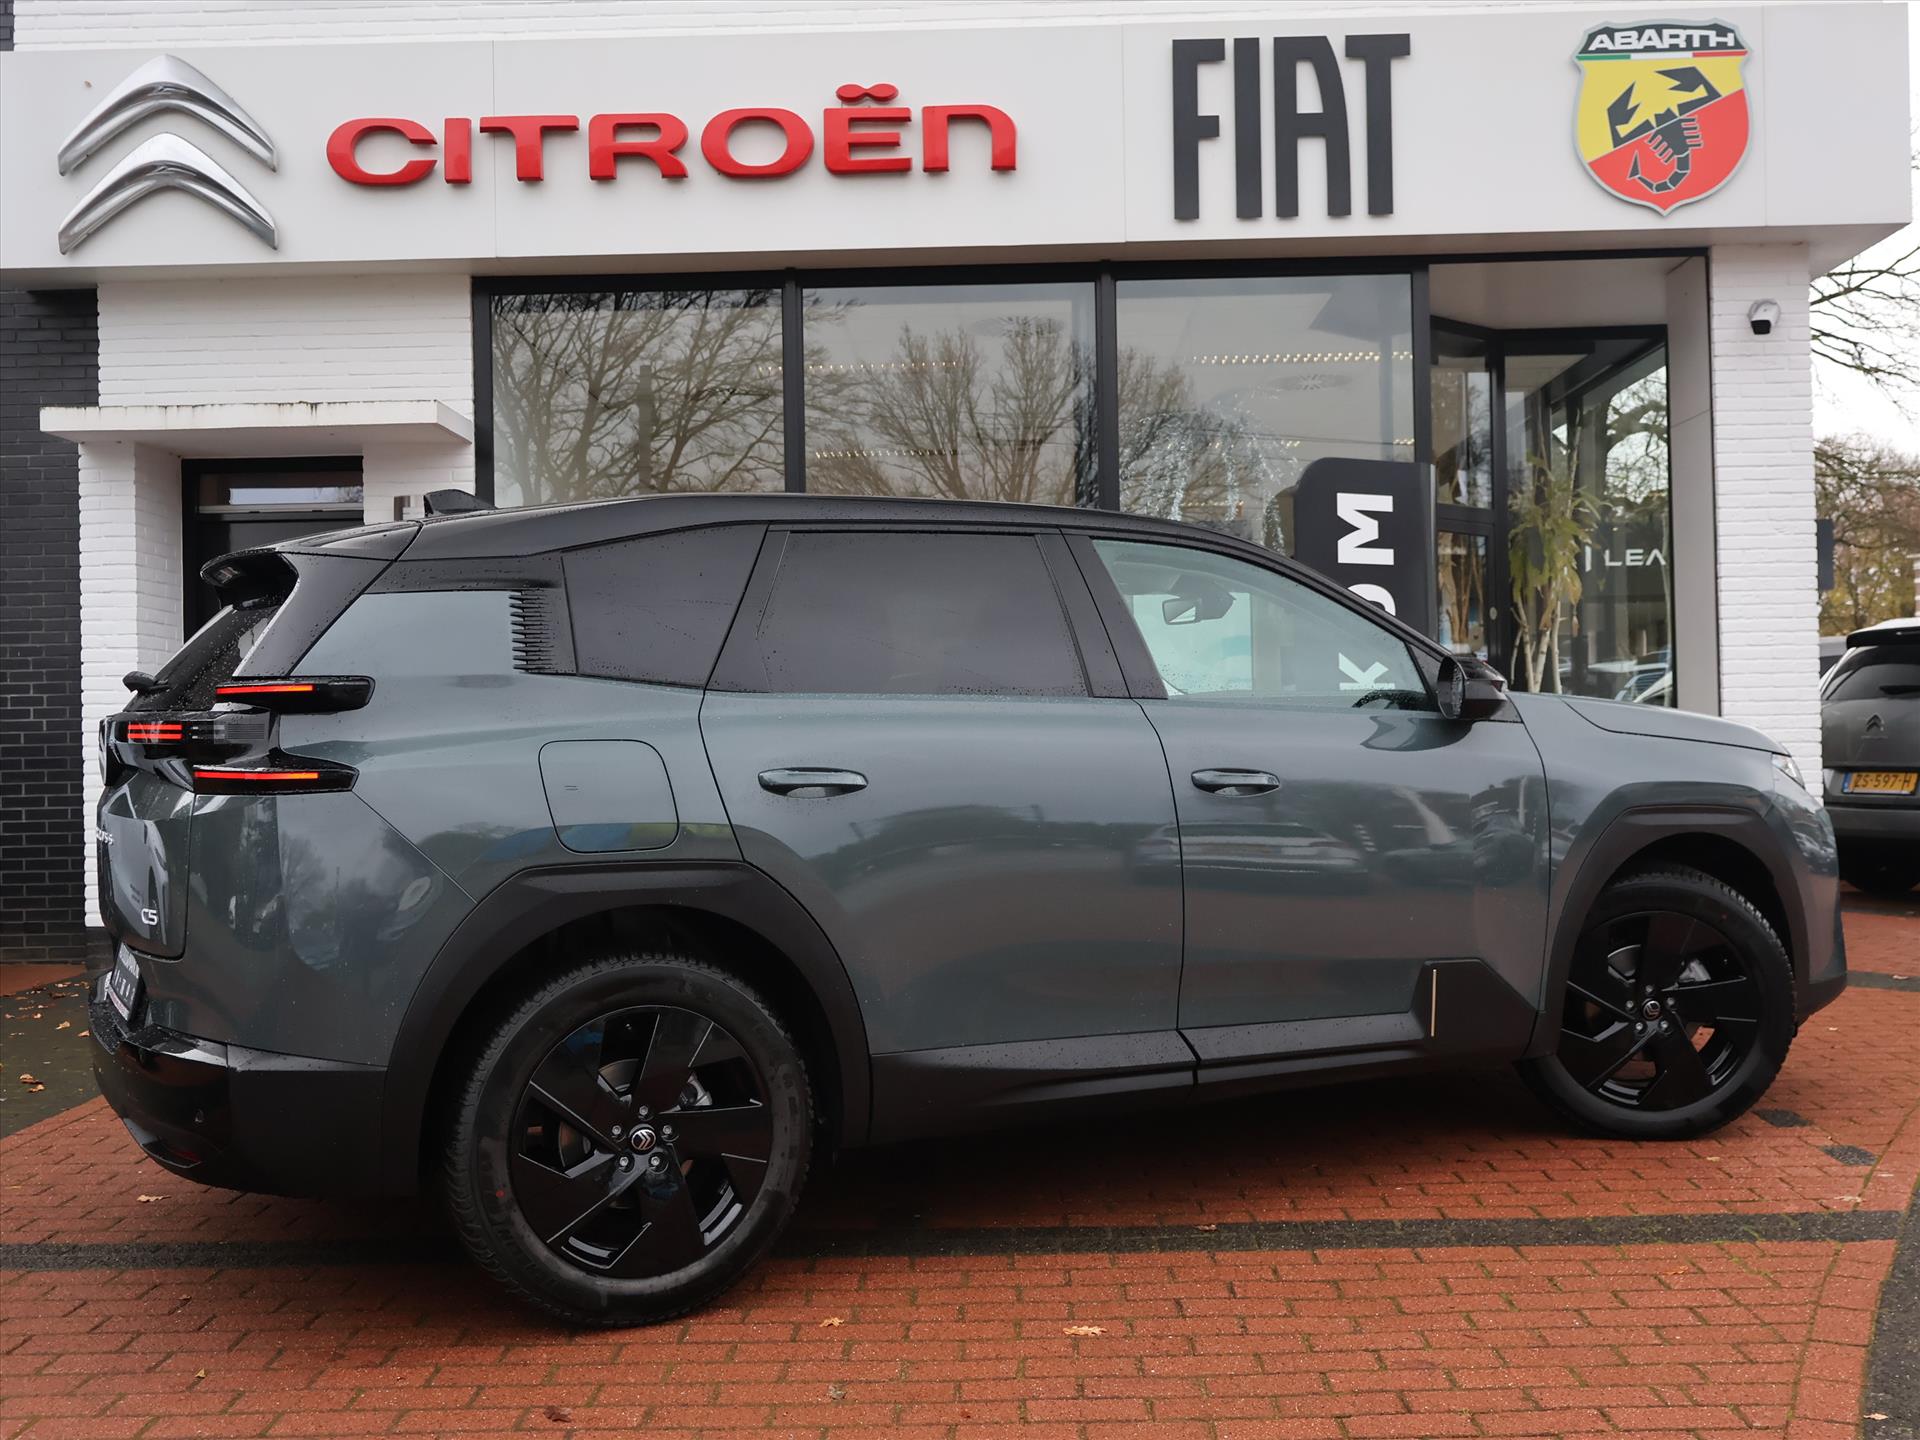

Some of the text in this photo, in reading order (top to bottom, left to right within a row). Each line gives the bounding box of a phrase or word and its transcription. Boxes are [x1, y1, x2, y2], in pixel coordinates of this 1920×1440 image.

[1588, 28, 1735, 51] ABARTH
[326, 83, 1018, 186] CITROËN
[1172, 33, 1411, 220] FIAT
[141, 907, 158, 926] C5
